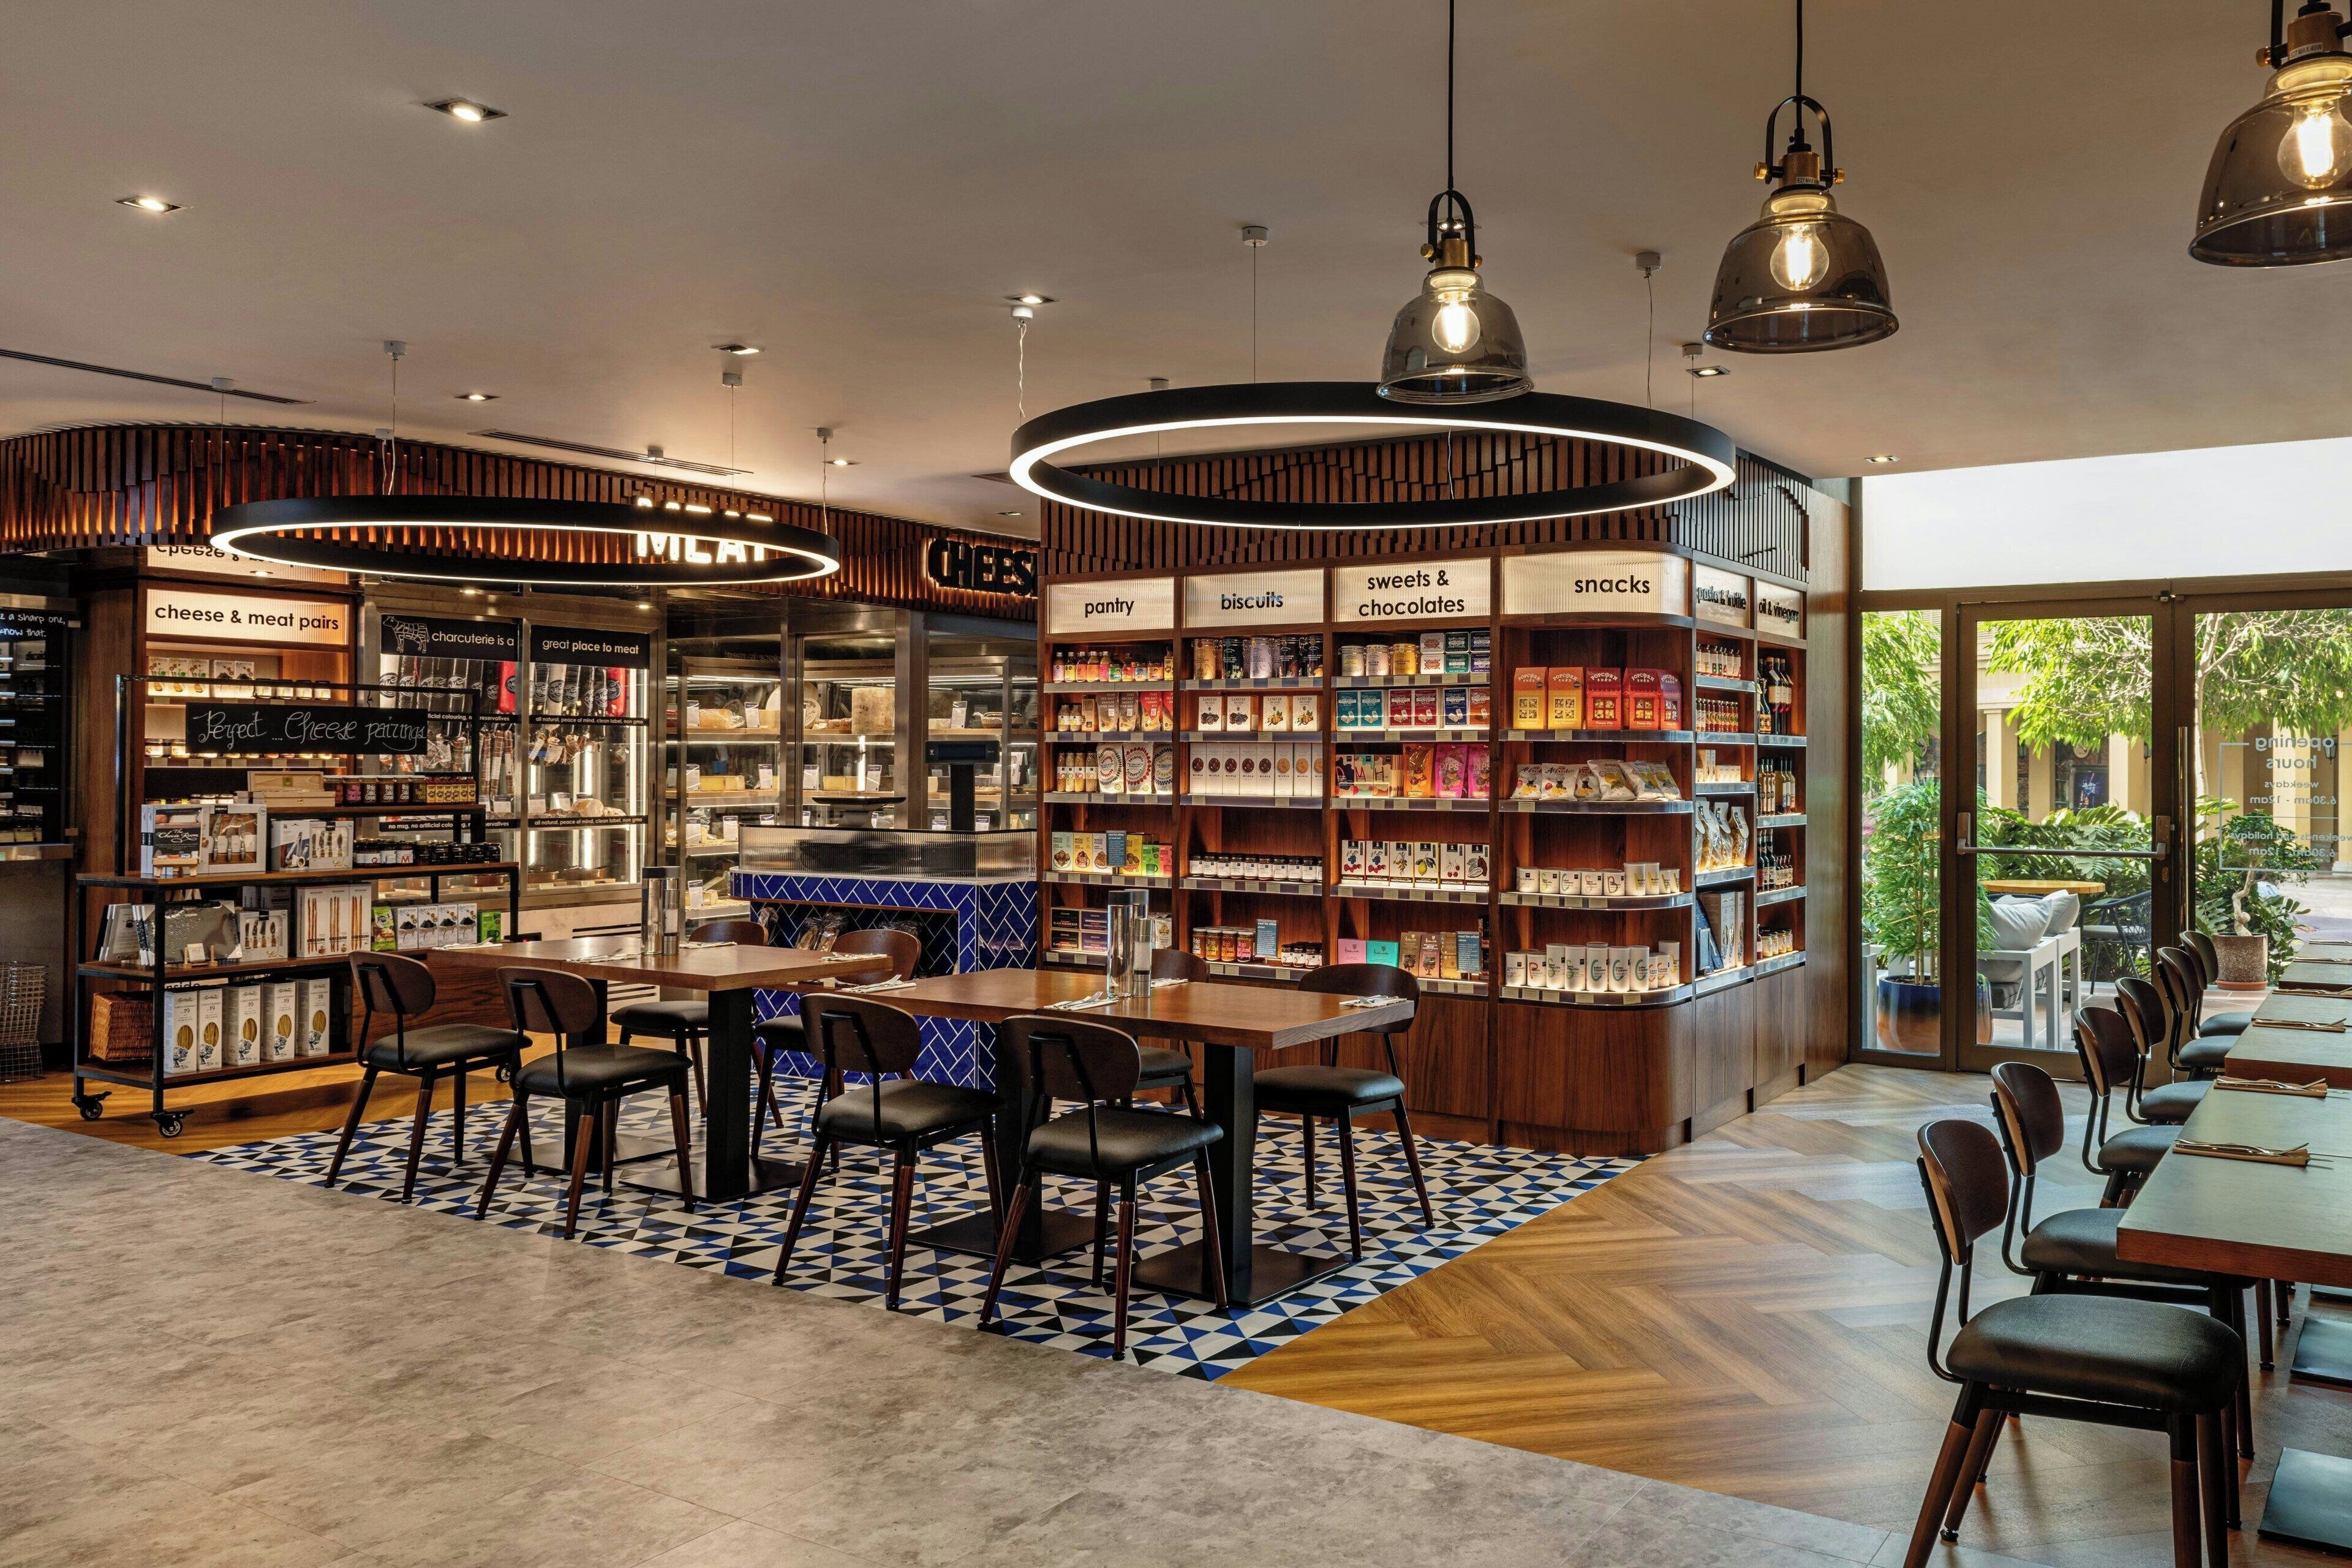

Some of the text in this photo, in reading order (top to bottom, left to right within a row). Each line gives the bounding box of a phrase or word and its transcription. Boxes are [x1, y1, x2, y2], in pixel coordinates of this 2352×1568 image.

[1367, 569, 1450, 590] sweets &
[1574, 575, 1651, 594] snacks
[1221, 591, 1283, 610] biscuits
[1697, 586, 1719, 603] pasta
[1085, 597, 1134, 618] pantry
[1359, 595, 1465, 617] chocolates
[18, 614, 45, 624] sharp
[49, 616, 66, 625] one,
[155, 605, 339, 630] cheese & meat pairs
[26, 628, 47, 637] that.
[432, 631, 514, 646] charcuterie is a
[543, 638, 639, 654] great place to meat
[193, 710, 427, 752] Perfect Cheese pairings
[1529, 962, 1538, 979] P
[1591, 959, 1602, 981] C
[1613, 959, 1624, 981] C
[1635, 959, 1646, 981] C
